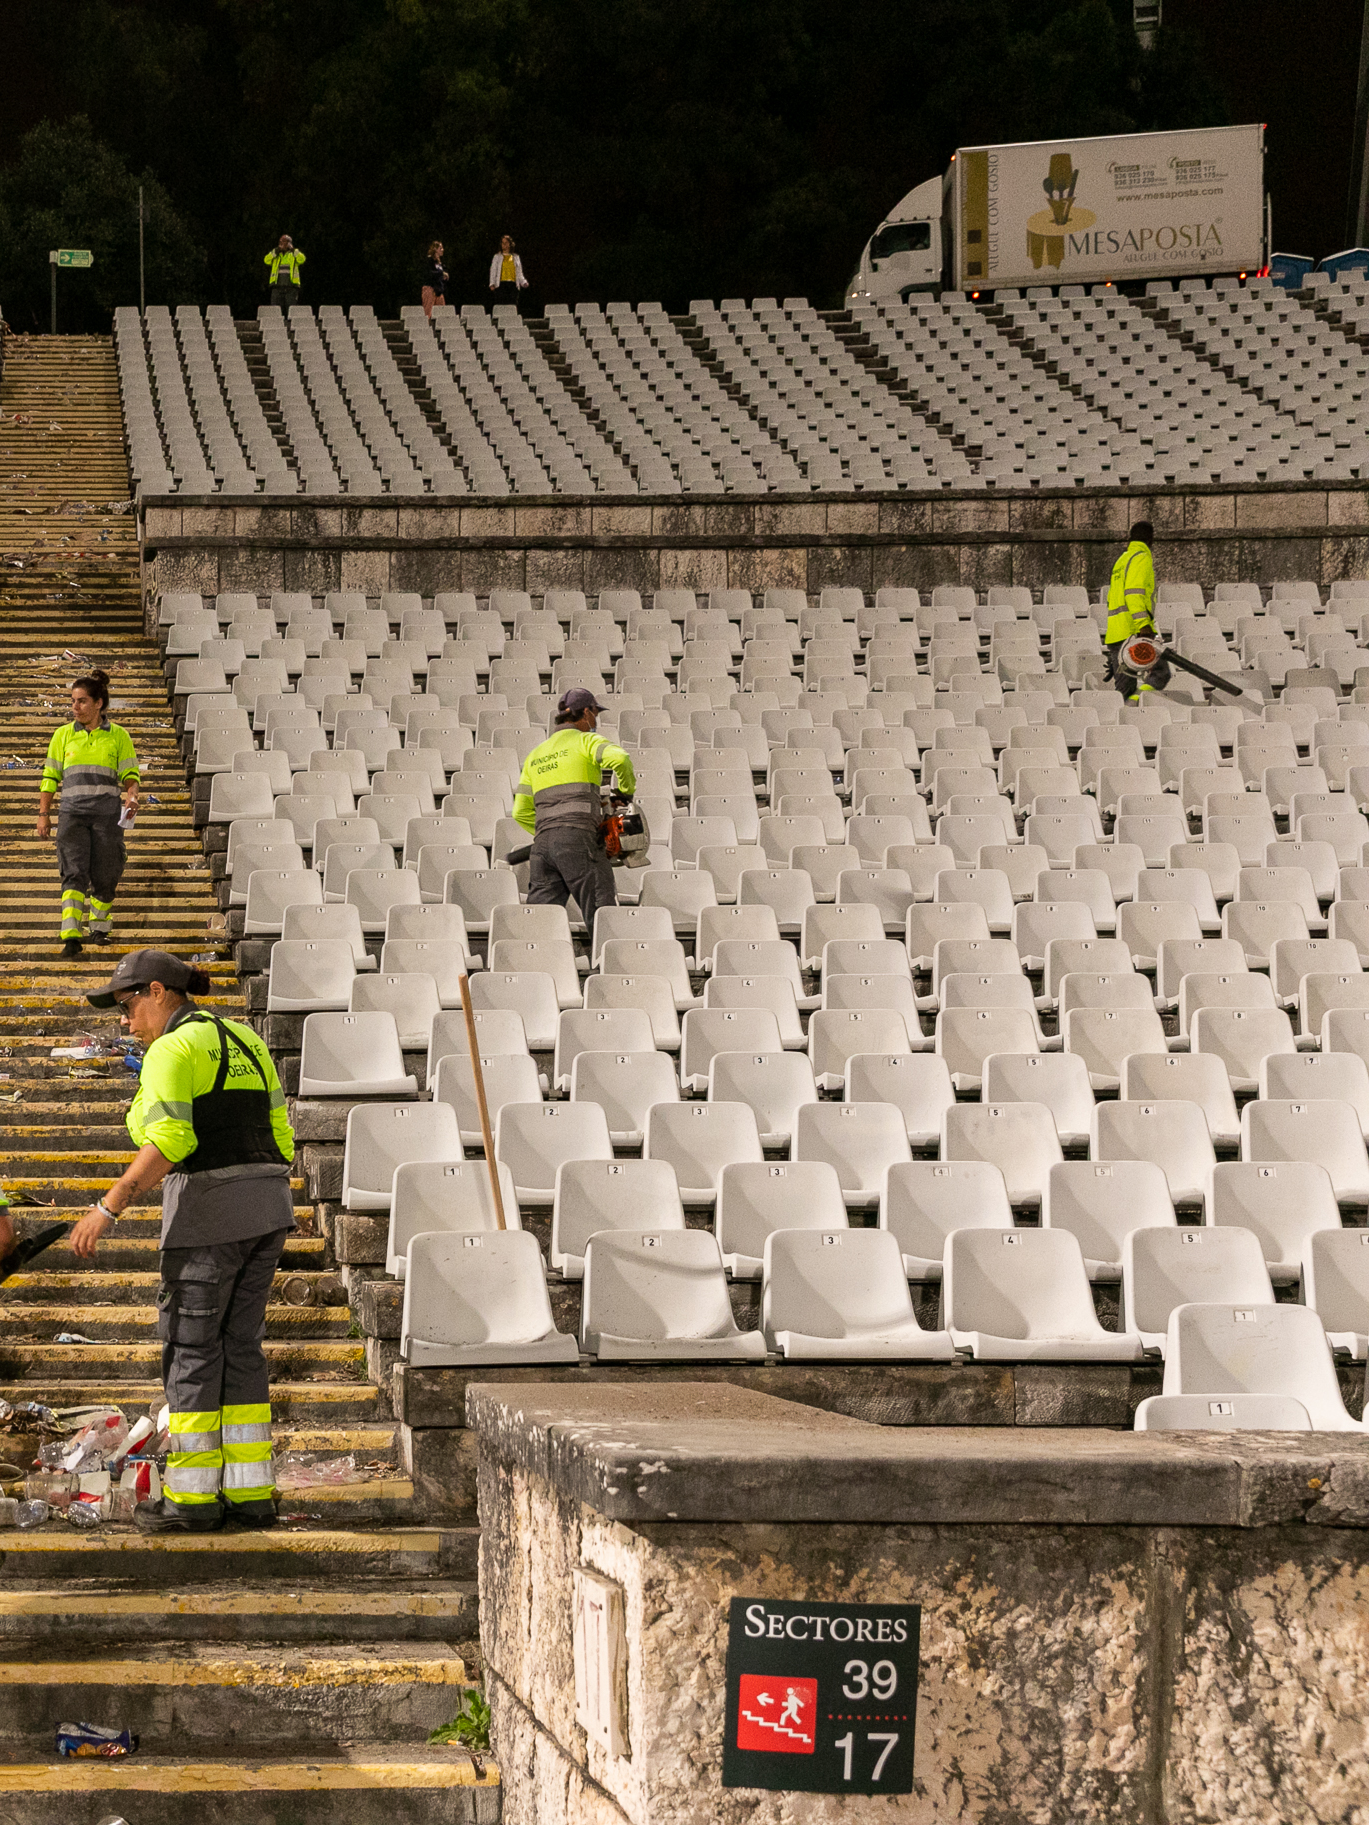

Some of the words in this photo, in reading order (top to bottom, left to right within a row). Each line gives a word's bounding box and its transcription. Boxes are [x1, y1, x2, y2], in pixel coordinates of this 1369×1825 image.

[1116, 187, 1223, 201] www.mesaposta.com
[1068, 223, 1222, 256] MESAPOSTA
[549, 1108, 554, 1116] 2
[697, 1108, 702, 1116] 3
[1144, 1107, 1150, 1115] 6
[1295, 1105, 1301, 1113] 7
[613, 1166, 619, 1174] 2
[774, 1168, 780, 1177] 3
[1263, 1169, 1269, 1177] 6
[649, 1238, 655, 1247] 2
[828, 1236, 834, 1245] 3
[1008, 1236, 1014, 1244] 4
[1187, 1234, 1194, 1243] 5
[744, 1604, 908, 1643] SECTORES
[842, 1660, 897, 1700] 39
[834, 1732, 900, 1781] 17
